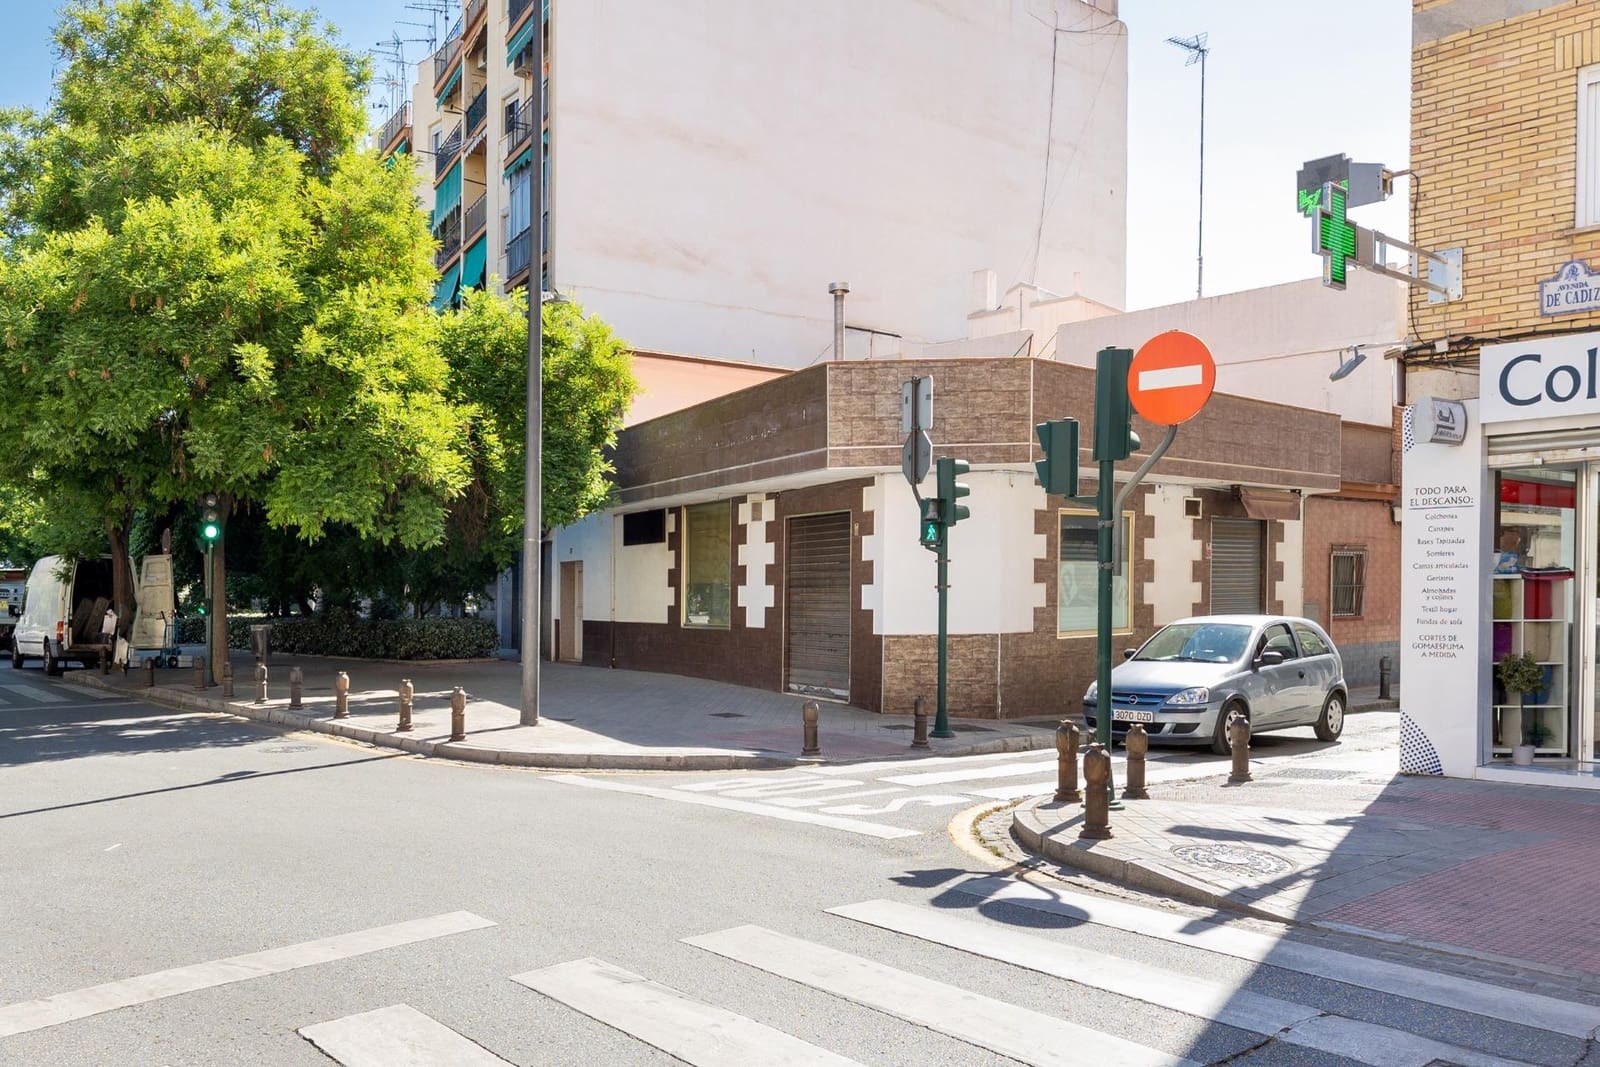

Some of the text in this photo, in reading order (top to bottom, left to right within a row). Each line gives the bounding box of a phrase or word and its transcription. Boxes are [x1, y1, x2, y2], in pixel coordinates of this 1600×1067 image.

[1546, 293, 1561, 308] DE
[1498, 347, 1598, 406] Col
[1415, 486, 1467, 496] TODO PARA
[1410, 495, 1474, 507] EL DESCANSO:
[1435, 561, 1469, 569] articuladas
[1115, 710, 1134, 720] 3070
